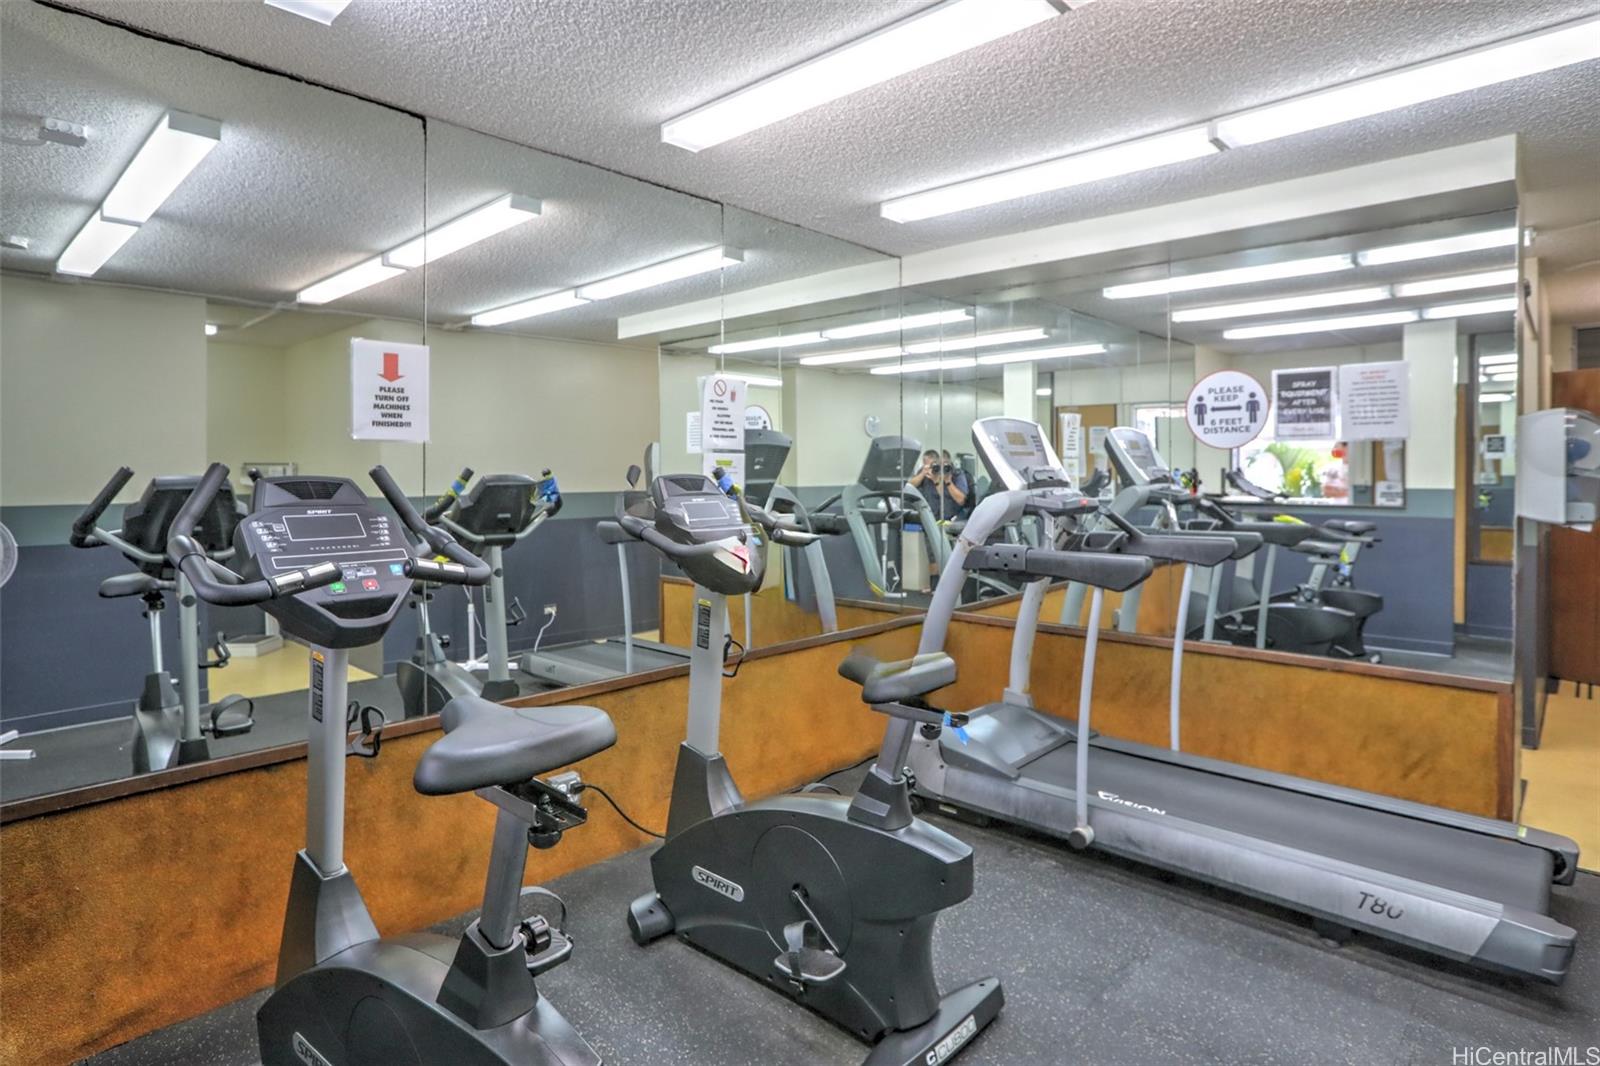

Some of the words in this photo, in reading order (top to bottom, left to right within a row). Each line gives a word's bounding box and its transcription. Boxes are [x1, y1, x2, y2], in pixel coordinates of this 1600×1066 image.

[1208, 386, 1244, 394] PLEASE
[1219, 417, 1243, 425] FEET
[1203, 425, 1251, 434] DISTANCE
[698, 871, 739, 896] SPIRIT
[1358, 891, 1404, 919] T80
